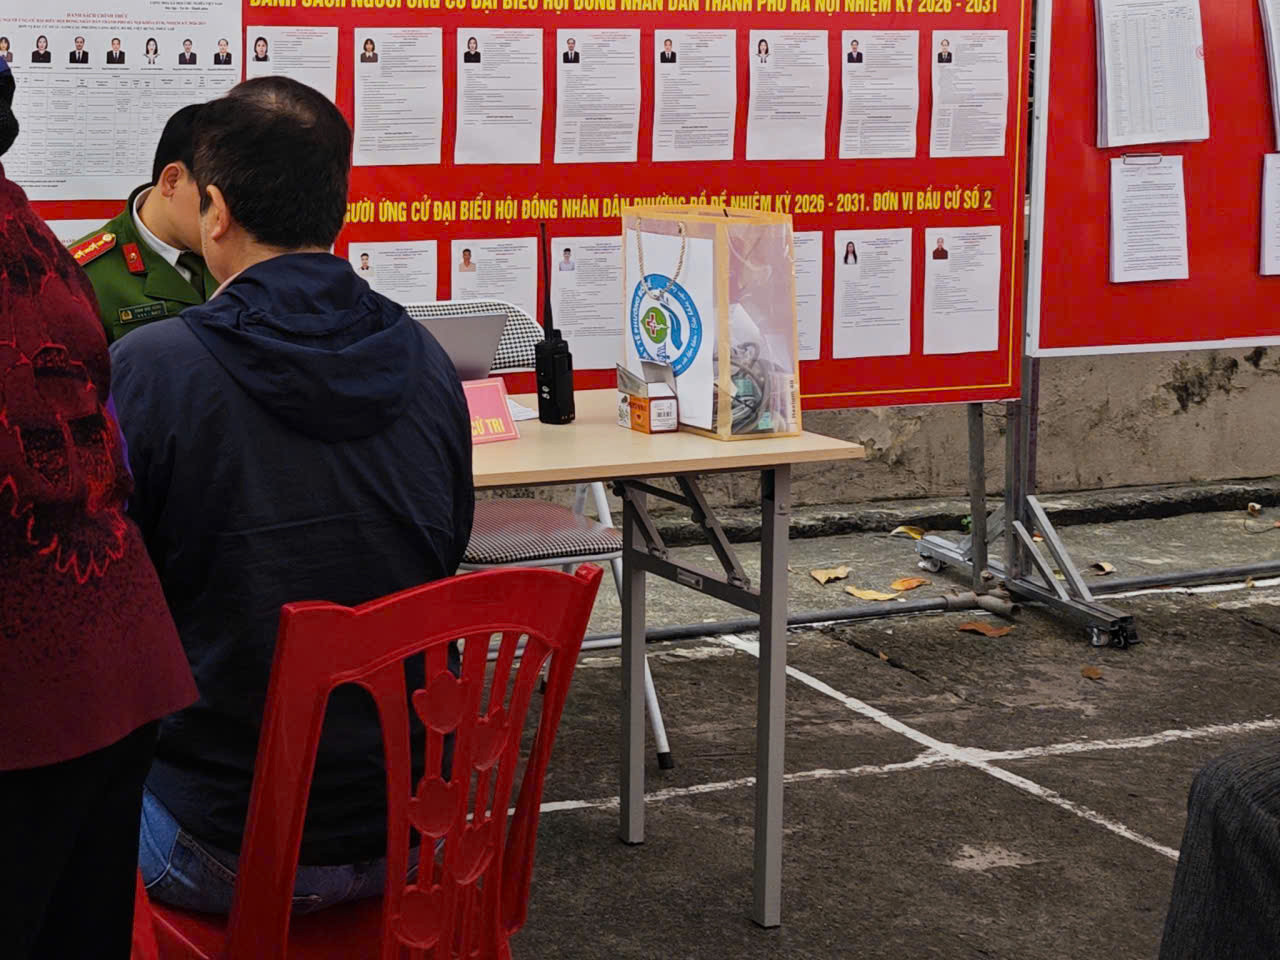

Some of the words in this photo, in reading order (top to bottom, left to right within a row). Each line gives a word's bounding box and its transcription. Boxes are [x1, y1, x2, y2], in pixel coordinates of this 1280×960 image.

[344, 197, 375, 223] ƯỜI
[378, 197, 407, 222] ỨNG
[410, 195, 432, 221] CỬ
[433, 201, 457, 224] ĐẠI
[459, 192, 492, 220] BIỂU
[494, 196, 518, 223] HỘI
[561, 195, 599, 218] NHÂN
[794, 194, 825, 214] 2026
[872, 191, 899, 212] ĐƠN
[901, 192, 914, 214] VỊ
[983, 191, 992, 208] 2
